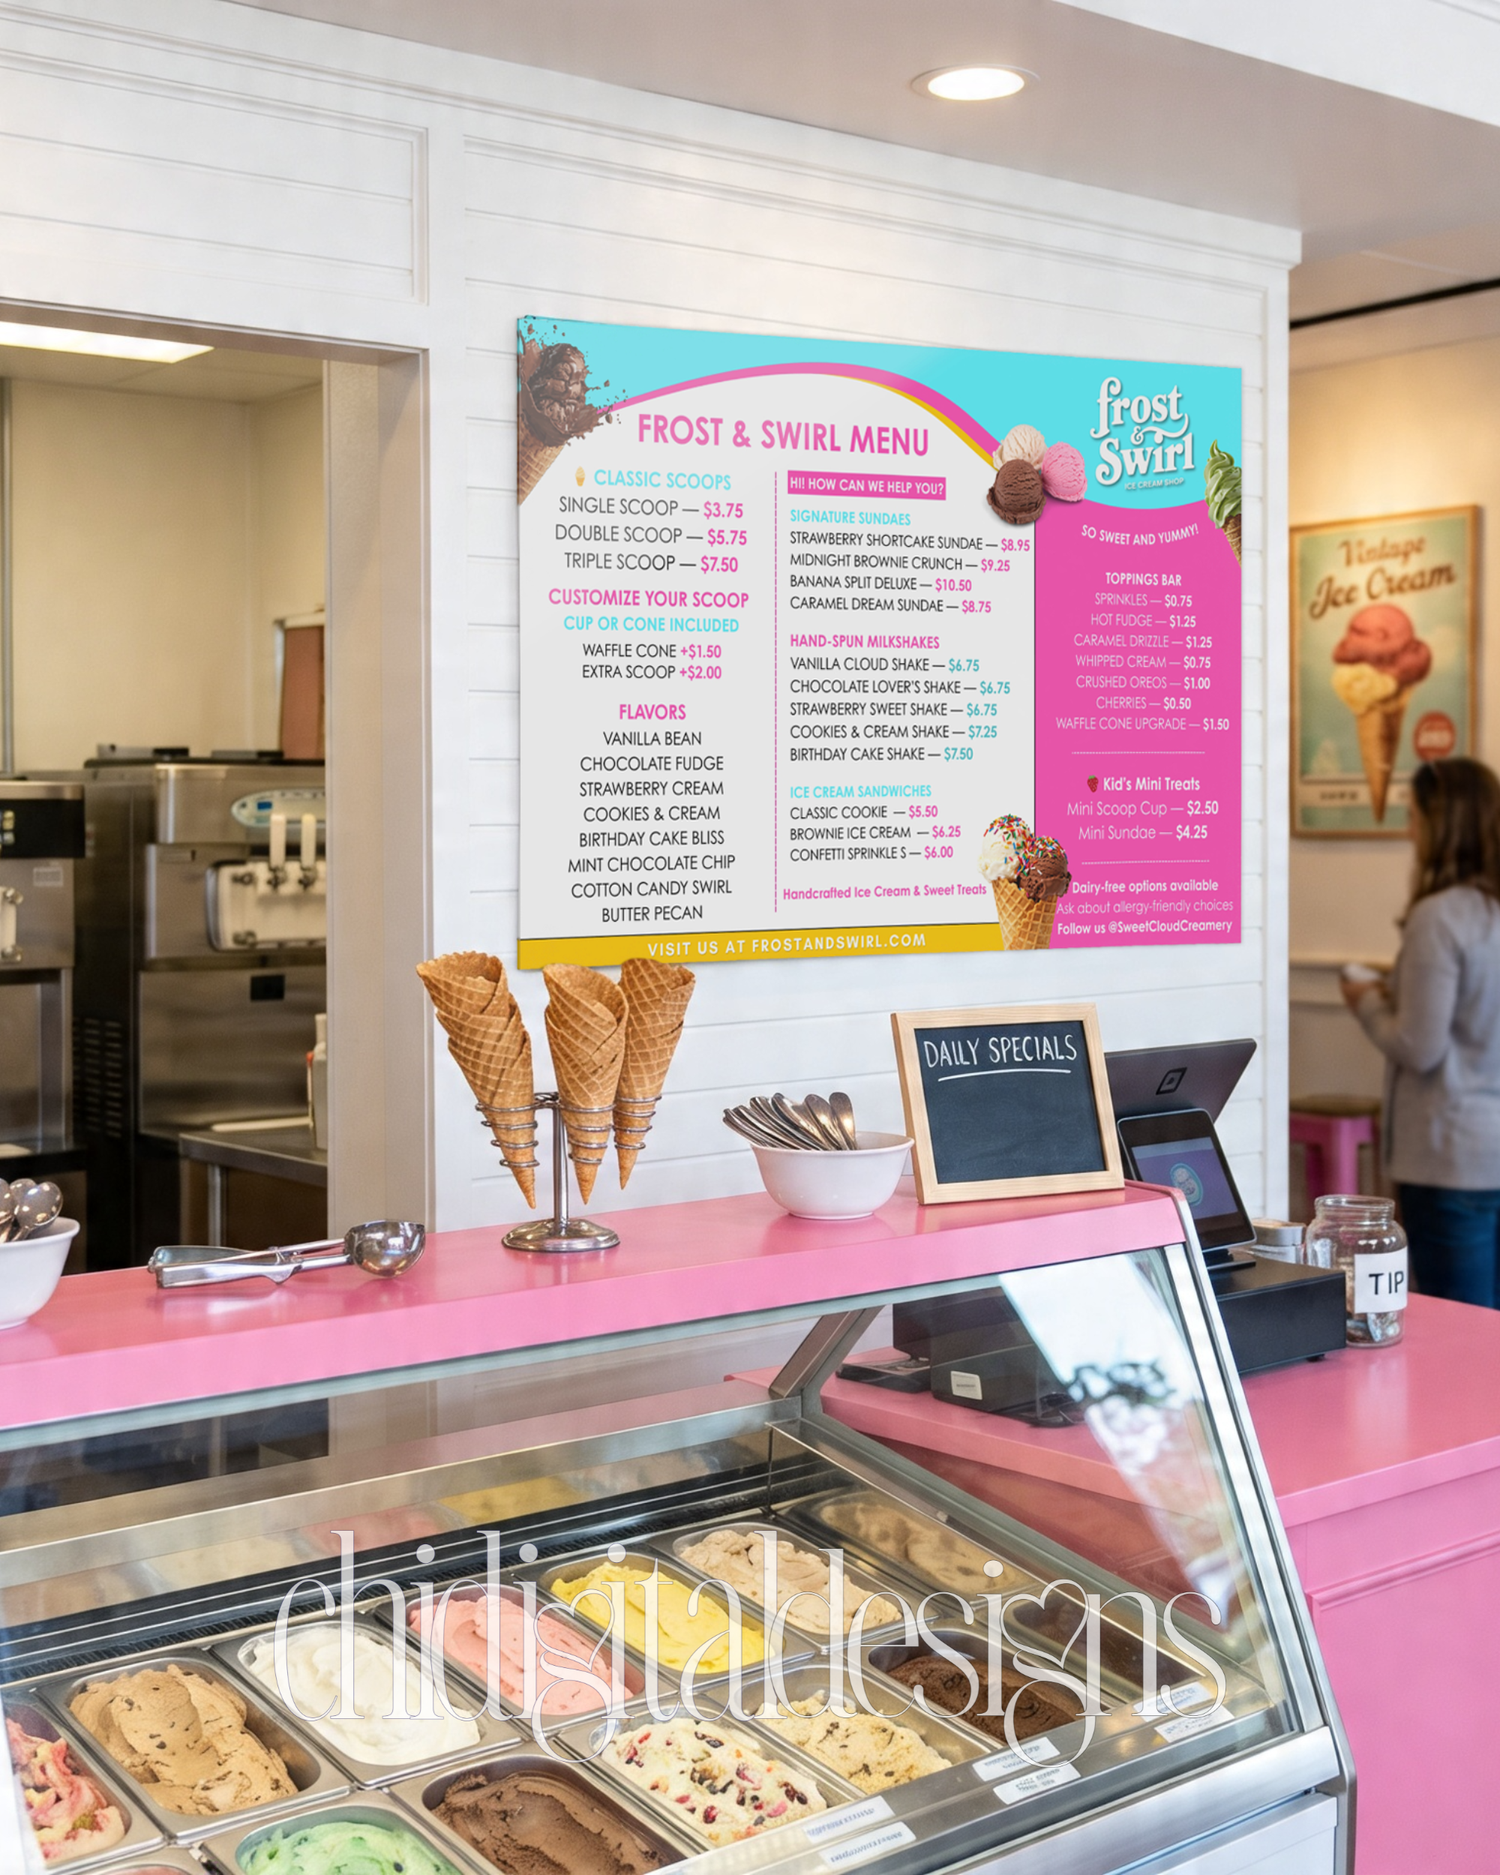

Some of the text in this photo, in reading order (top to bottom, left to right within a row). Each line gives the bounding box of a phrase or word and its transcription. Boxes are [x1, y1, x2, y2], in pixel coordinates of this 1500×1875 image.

[1089, 376, 1183, 438] frost
[639, 414, 928, 456] FROST & SWIRL MENU
[1095, 432, 1195, 486] Swirl
[594, 469, 731, 490] CLASSIC SCOOPS
[791, 477, 944, 495] HI! HOW CAN WE HELP YOU?
[1124, 477, 1185, 490] ICE CREAM SHOP
[559, 496, 743, 519] SINGLE SCOOP $3.75
[791, 509, 911, 526] SIGNATURE SUNDAES
[556, 524, 747, 547] DOUBLE SCOOP $5.75
[790, 531, 1030, 552] STRAWBERRY SHORTCAKE SUNDAE $8.95
[1082, 523, 1198, 545] SO SWEET AND YUMMY!
[1338, 536, 1426, 567] Vintage
[564, 552, 738, 574] TRIPLE SCOOP $7.50
[790, 553, 1010, 572] MIDNIGHT BROWNIE CRUNCH $9.25
[1106, 572, 1181, 586] TOPPINGS BAR
[549, 588, 749, 608] CUSTOMIZE YOUR SCOOP
[1095, 592, 1192, 608] SPRINKLES $0.75
[1308, 563, 1457, 621] Ice Cream
[790, 596, 991, 614] CARAMEL DREAM SUNDAE $8.75
[564, 616, 739, 632] CUP OR CONE INCLUDED
[1091, 613, 1196, 628] HOT FUDGE $1.25
[791, 634, 939, 649] HAND-SPUN MILKSHAKES
[1074, 634, 1212, 649] CARAMEL DRIZZLE $1.25
[583, 644, 721, 660] WAFFLE CONE +$1.50
[790, 657, 979, 673] VANILLA CLOUD SHAKE $6.75
[1076, 655, 1211, 670] WHIPPED CREAM $0.75
[790, 679, 1010, 695] CHOCOLATE LOVER'S SHAKE $6.75
[790, 702, 997, 717] STRAWBERRY SWEET SHAKE $6.75
[1096, 696, 1191, 711] CHERRIES $0.50
[620, 704, 686, 720] FLAVORS
[1056, 717, 1229, 731] WAFFLE CONE UPGRADE $1.50
[603, 731, 701, 746] VANILLA BEAN
[580, 756, 723, 771] CHOCOLATE FUDGE
[580, 781, 723, 797] STRAWBERRY CREAM
[791, 785, 931, 798] ICE CREAM SANDWICHES
[1104, 777, 1200, 791] Kid's Mini Treats
[584, 806, 720, 822] COOKIES & CREAM
[790, 805, 938, 820] CLASSIC COOKIE $5.50
[1067, 800, 1218, 817] Mini Scoop Cup $2.50
[580, 830, 724, 847] BIRTHDAY CAKE BLISS
[790, 825, 961, 840] BROWNIE ICE CREAM $6.25
[1079, 825, 1207, 840] Mini Sundae $4.25
[568, 855, 735, 872] MINT CHOCOLATE CHIP
[784, 884, 986, 900] Handcrafted Ice Cream & Sweet Treats
[1073, 879, 1218, 895] Dairy-free options available
[1057, 899, 1233, 915] Ask about allergy-friendly choices
[1058, 920, 1232, 934] Follow us @SweetCloudCreamery
[648, 934, 925, 956] VISIT US AT FROSTANDSWIRL.COM
[924, 1035, 1077, 1067] DAILY SPECIALS
[1368, 1269, 1404, 1297] TIP
